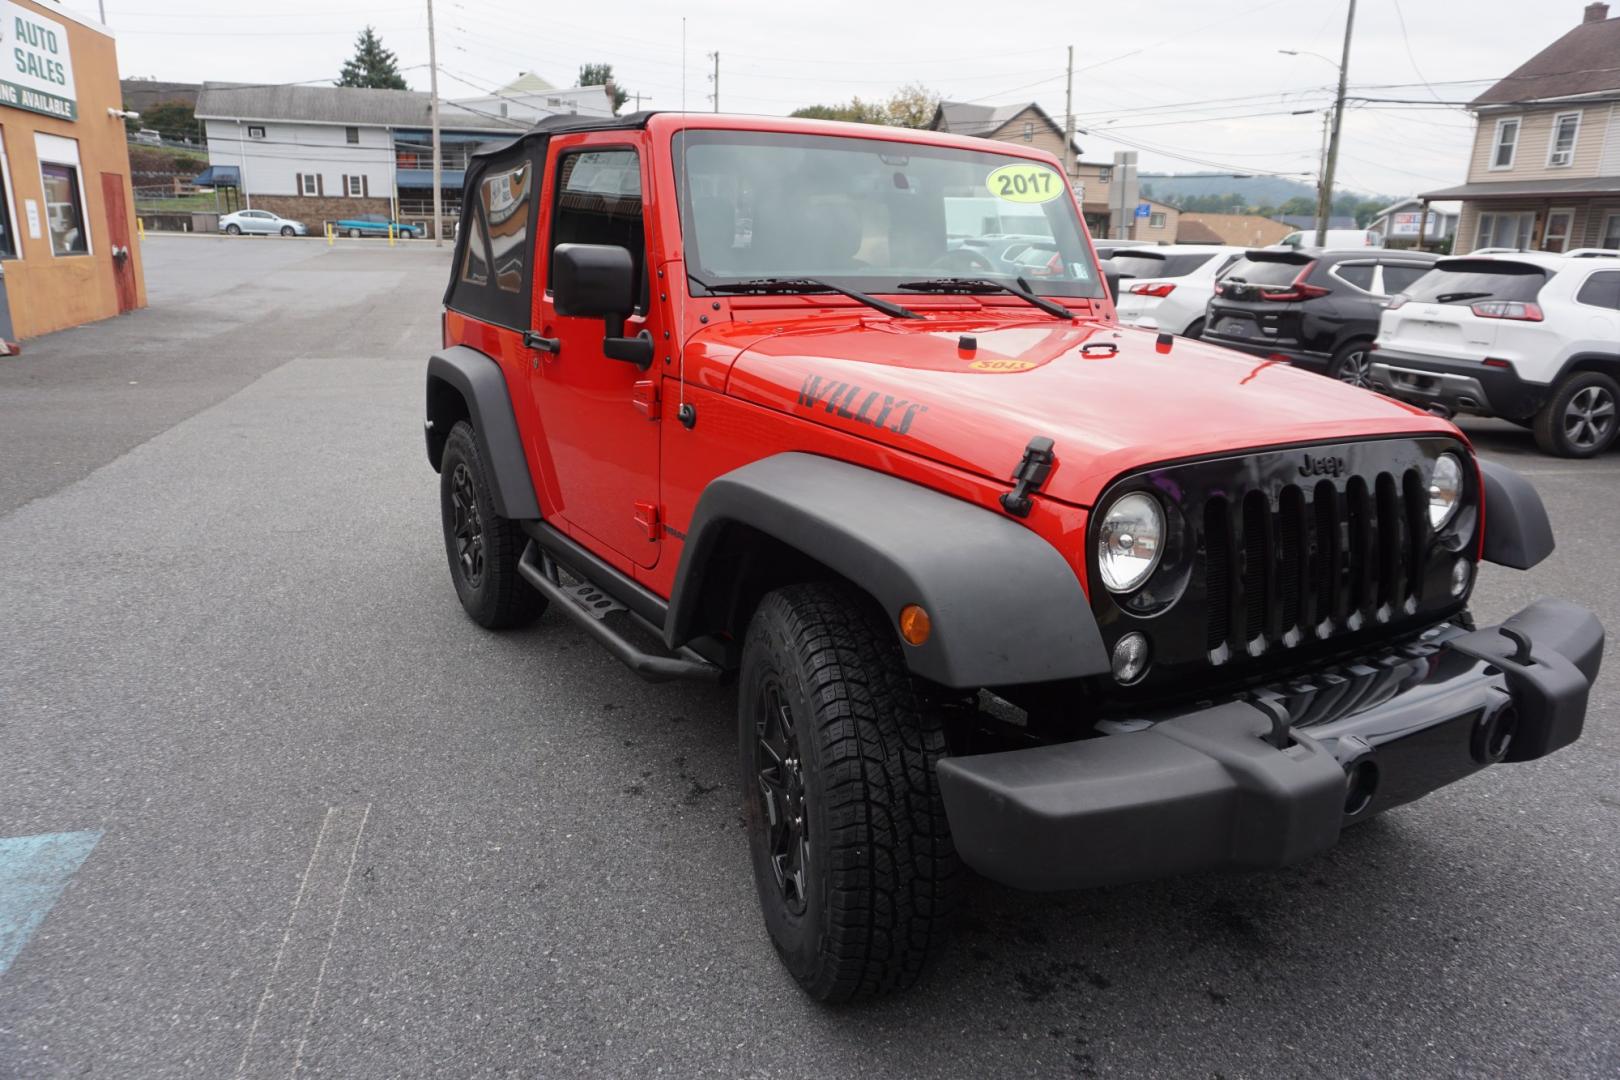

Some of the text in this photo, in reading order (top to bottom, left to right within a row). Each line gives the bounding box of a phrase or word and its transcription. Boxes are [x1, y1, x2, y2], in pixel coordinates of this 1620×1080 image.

[15, 15, 58, 54] AUTO
[14, 47, 65, 86] SALES
[21, 90, 71, 116] AVAILABLE
[997, 172, 1051, 196] 2017
[1298, 453, 1345, 478] Jeep
